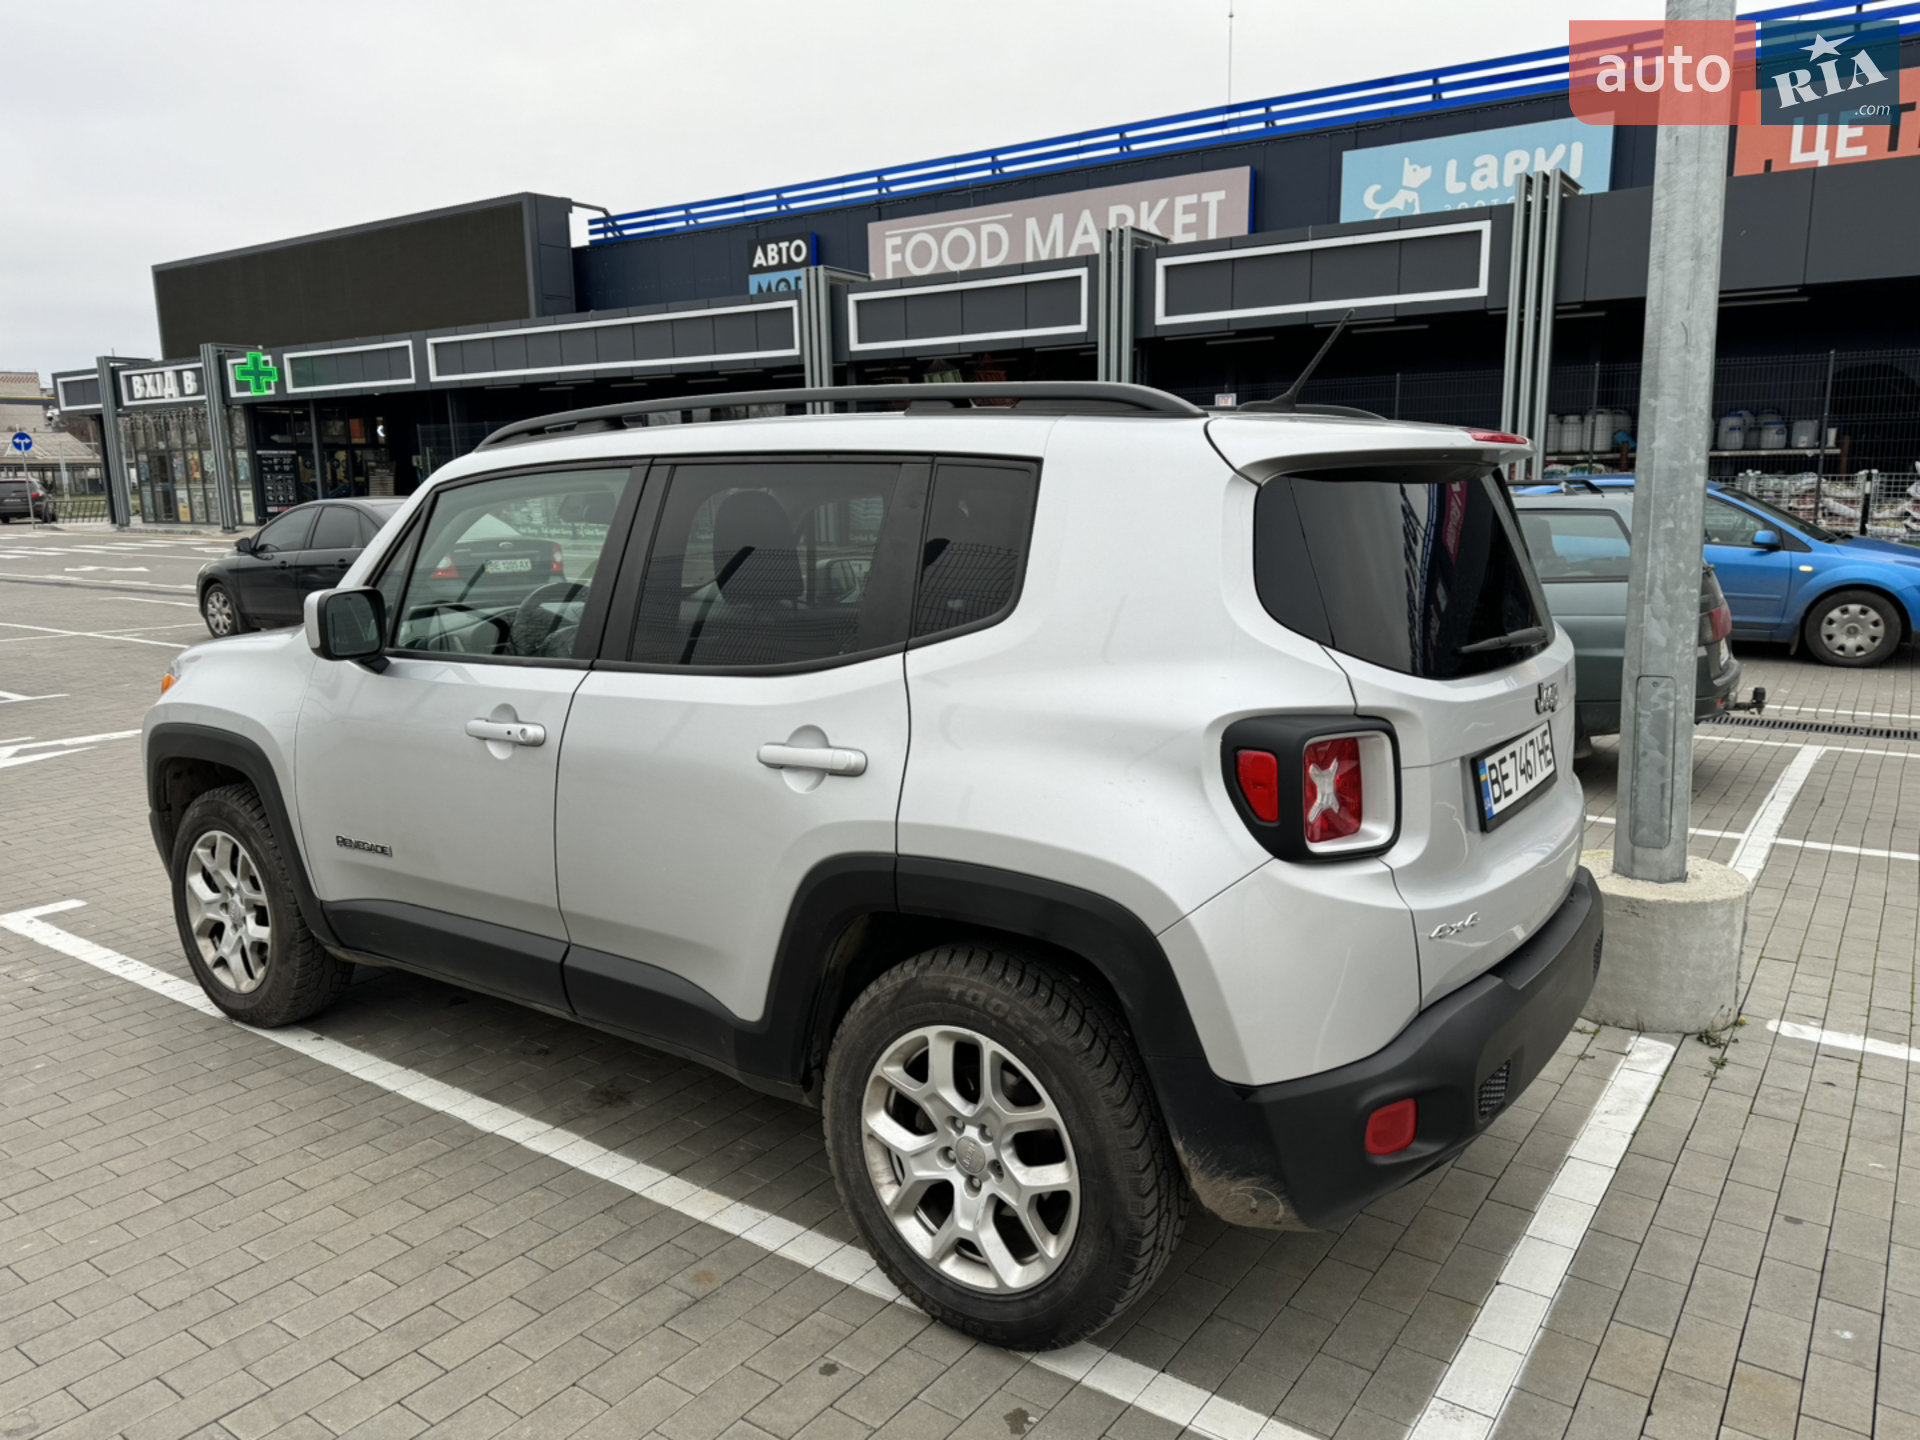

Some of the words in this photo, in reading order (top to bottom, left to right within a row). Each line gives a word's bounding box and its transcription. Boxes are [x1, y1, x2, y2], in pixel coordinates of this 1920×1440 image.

[752, 238, 808, 268] АВТО
[885, 222, 1010, 281] FOOD
[131, 370, 180, 399] ВХІД
[336, 835, 392, 857] RENEGADE
